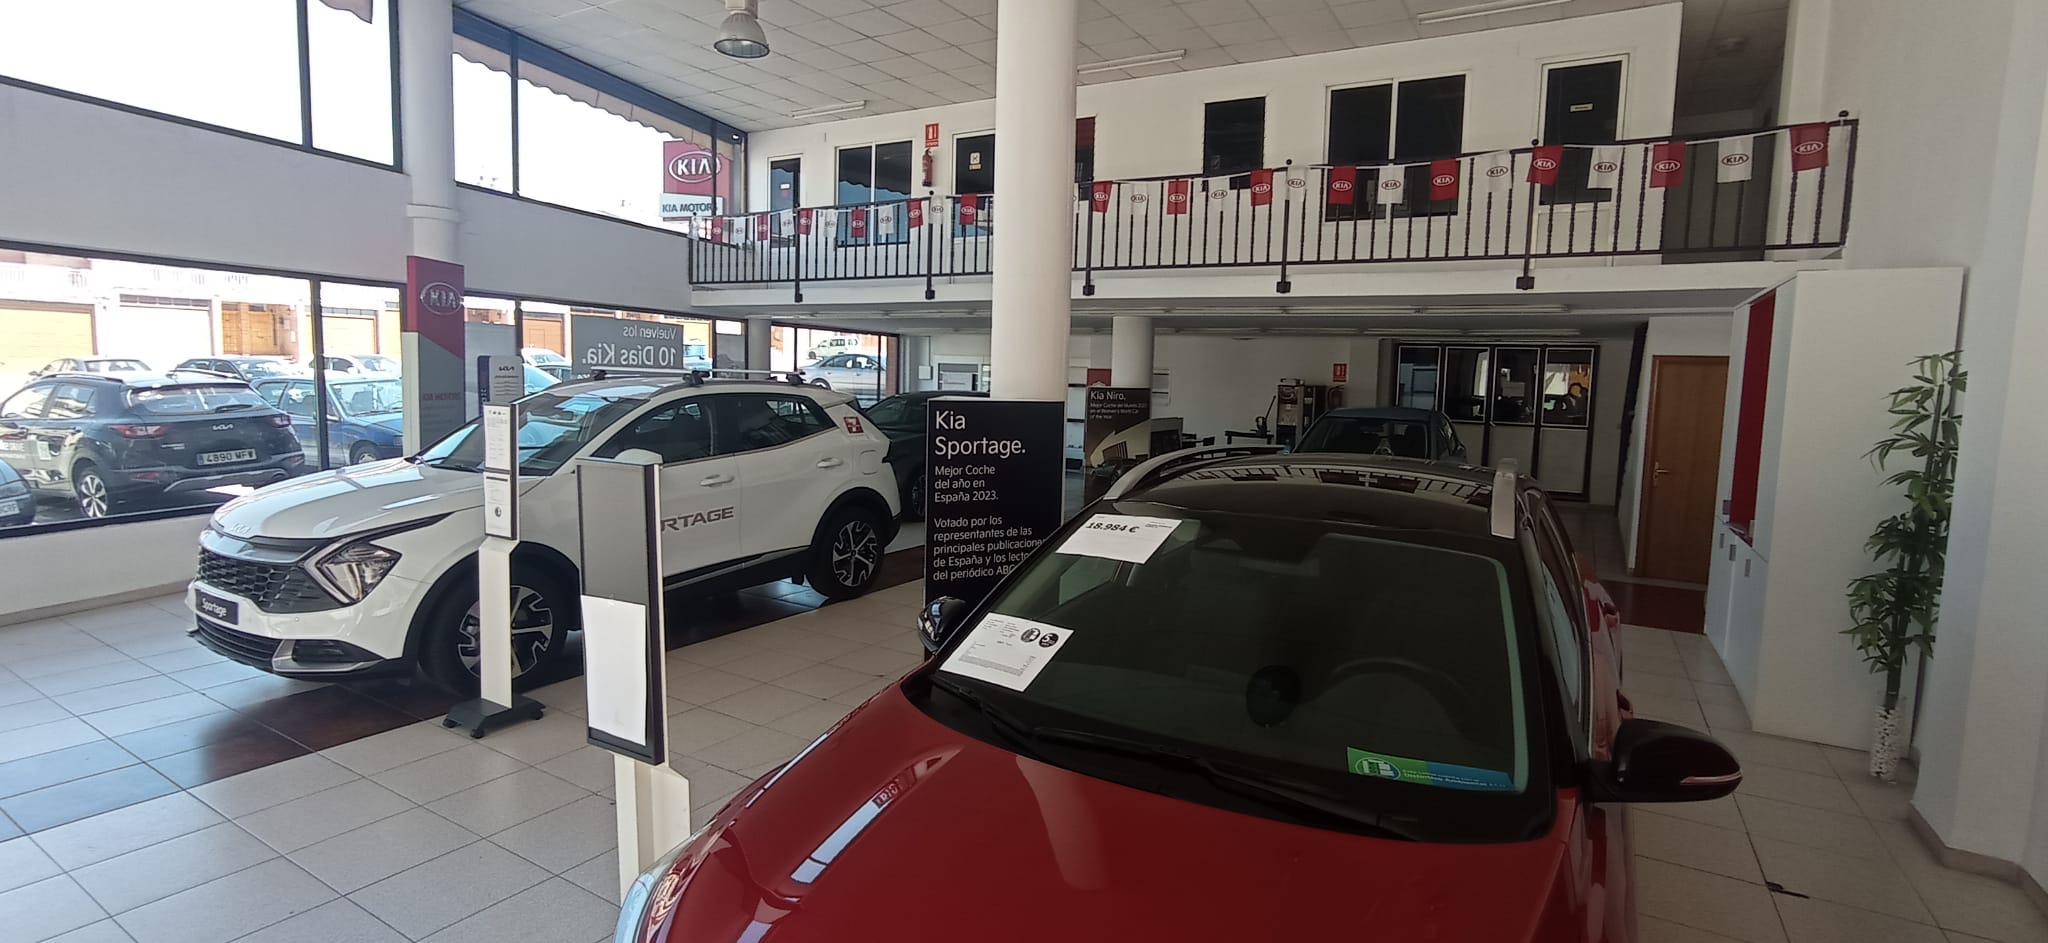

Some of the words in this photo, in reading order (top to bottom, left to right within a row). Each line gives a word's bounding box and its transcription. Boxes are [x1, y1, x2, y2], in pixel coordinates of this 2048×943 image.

[1798, 142, 1820, 153] KIA
[1536, 160, 1553, 169] KIA
[1725, 155, 1745, 165] KIA
[677, 158, 712, 176] KIA
[1489, 167, 1505, 176] KIA
[1596, 163, 1614, 172] KIA
[1658, 161, 1677, 171] KIA
[1289, 179, 1303, 187] KIA
[1334, 182, 1349, 190] KIA
[1382, 181, 1398, 190] KIA
[1435, 176, 1451, 185] KIA
[1212, 190, 1226, 198] KIA
[1254, 184, 1269, 193] KIA
[662, 203, 678, 213] KIA
[680, 202, 718, 212] MOTOR
[1091, 391, 1104, 400] Kia
[936, 410, 966, 430] Kia
[935, 436, 1026, 460] Sportage.
[935, 465, 964, 478] Mejor
[965, 464, 996, 475] Coche
[935, 479, 950, 489] del
[952, 478, 971, 489] año
[973, 479, 985, 488] en
[935, 491, 970, 505] España
[972, 490, 999, 501] 2023.
[660, 506, 734, 532] RTAGE
[933, 517, 969, 528] Votado
[970, 517, 987, 528] por
[989, 515, 1003, 525] los
[1085, 522, 1128, 532] 18.984
[933, 529, 1005, 543] representantes
[1006, 527, 1018, 537] de
[1020, 526, 1032, 536] las
[933, 542, 985, 557] principales
[933, 558, 946, 568] de
[948, 555, 983, 568] España
[985, 556, 991, 566] y
[993, 553, 1006, 563] los
[1008, 552, 1029, 561] lecto
[933, 570, 948, 580] del
[950, 568, 994, 581] periódico
[202, 597, 227, 618] Sportage
